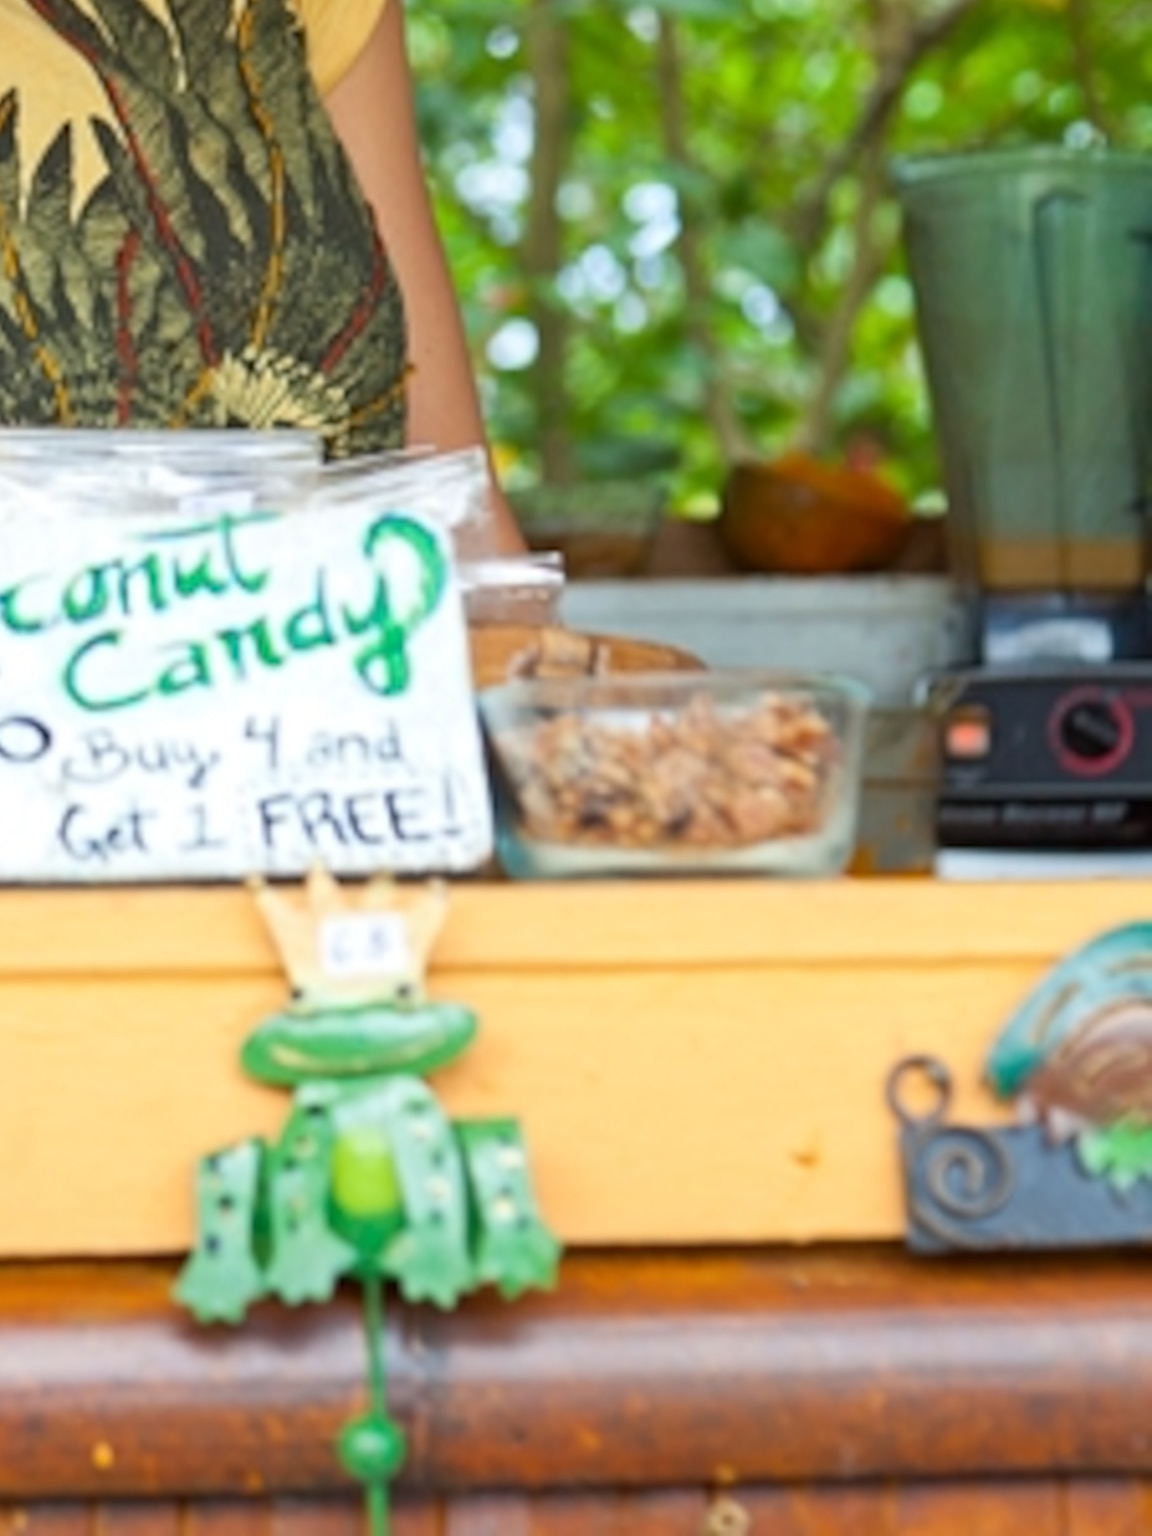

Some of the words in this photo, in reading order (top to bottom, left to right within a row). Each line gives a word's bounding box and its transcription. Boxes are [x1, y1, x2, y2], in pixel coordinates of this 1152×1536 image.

[61, 513, 448, 713] Candy
[242, 715, 283, 770] 4
[306, 718, 404, 767] and
[57, 802, 157, 863] Get
[178, 805, 227, 852] 1
[256, 768, 465, 851] FREE!
